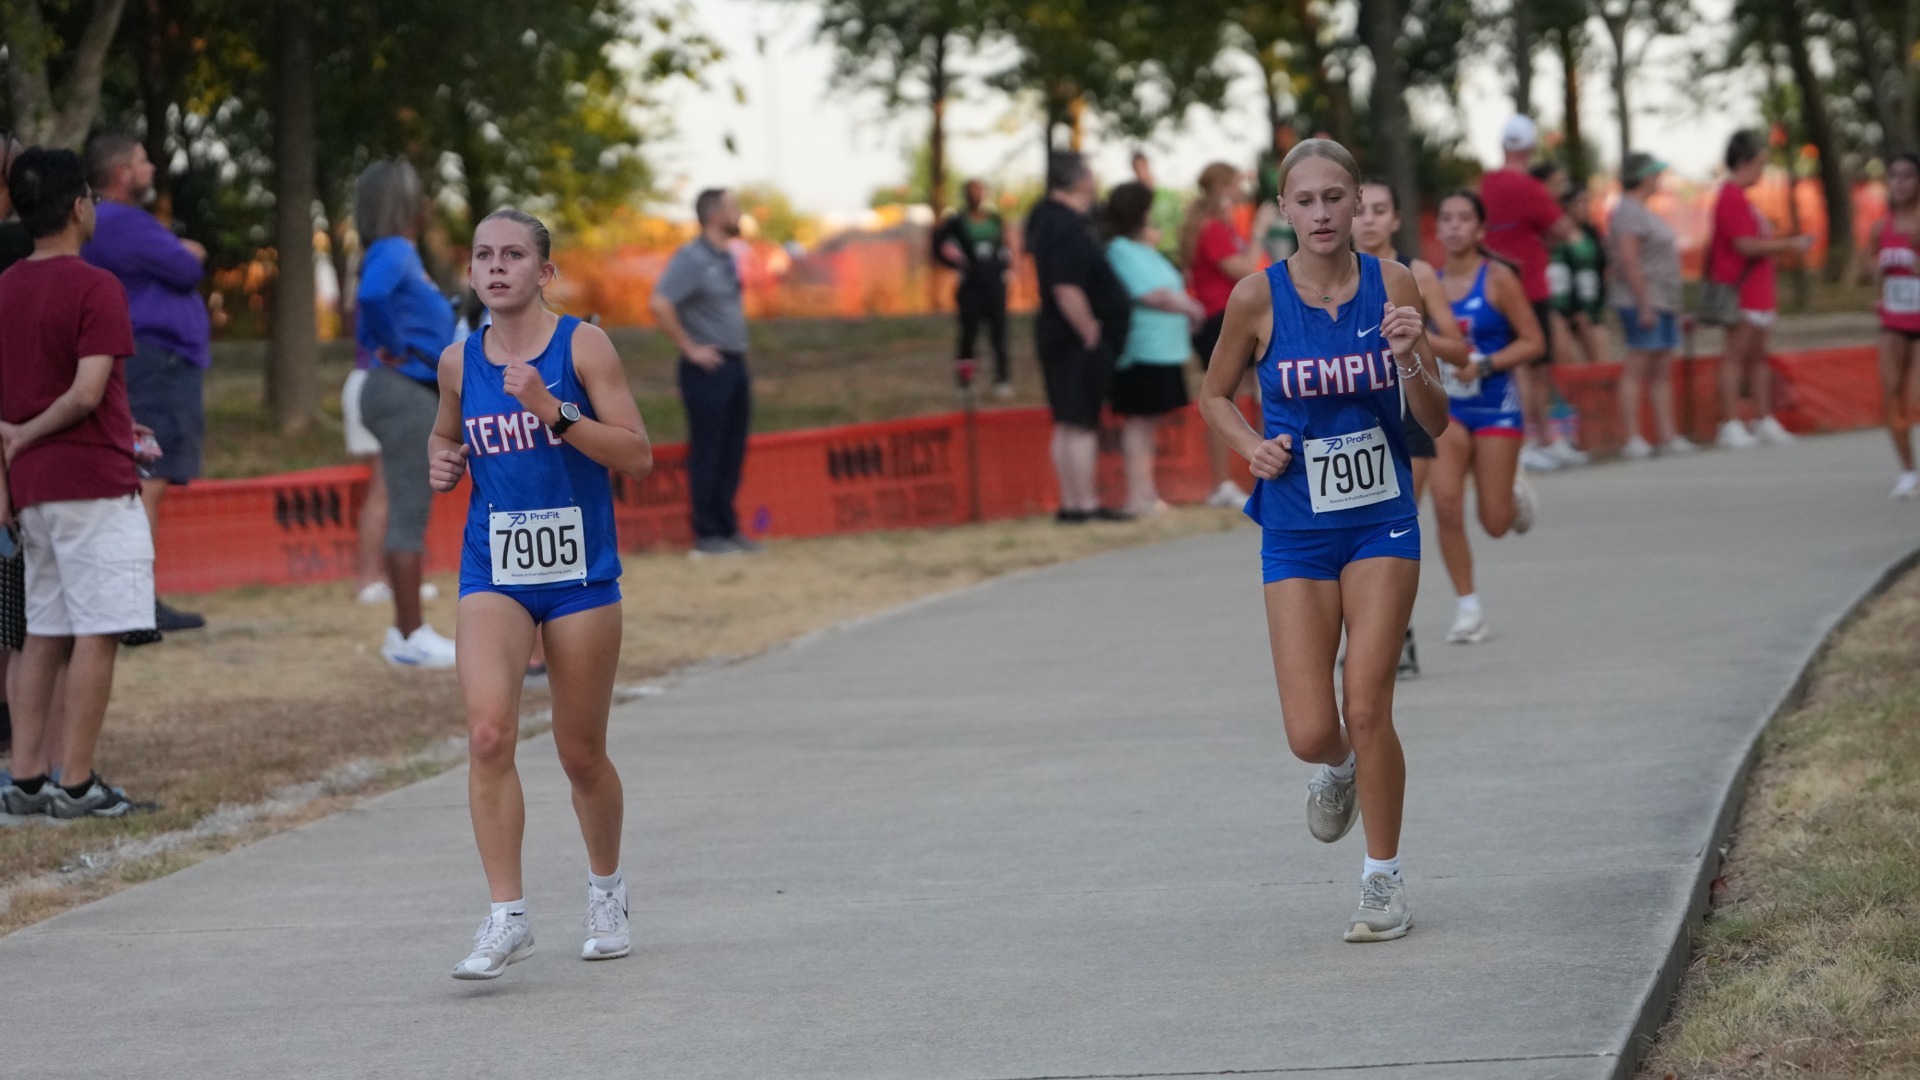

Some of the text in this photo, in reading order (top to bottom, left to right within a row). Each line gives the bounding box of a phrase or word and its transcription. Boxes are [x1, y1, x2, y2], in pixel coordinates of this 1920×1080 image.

[1278, 349, 1394, 398] TEMPLE
[465, 403, 580, 456] TEMPL
[1345, 432, 1373, 445] ProFit
[1313, 444, 1385, 497] 7907
[530, 511, 560, 521] ProFit
[496, 525, 578, 570] 7905
